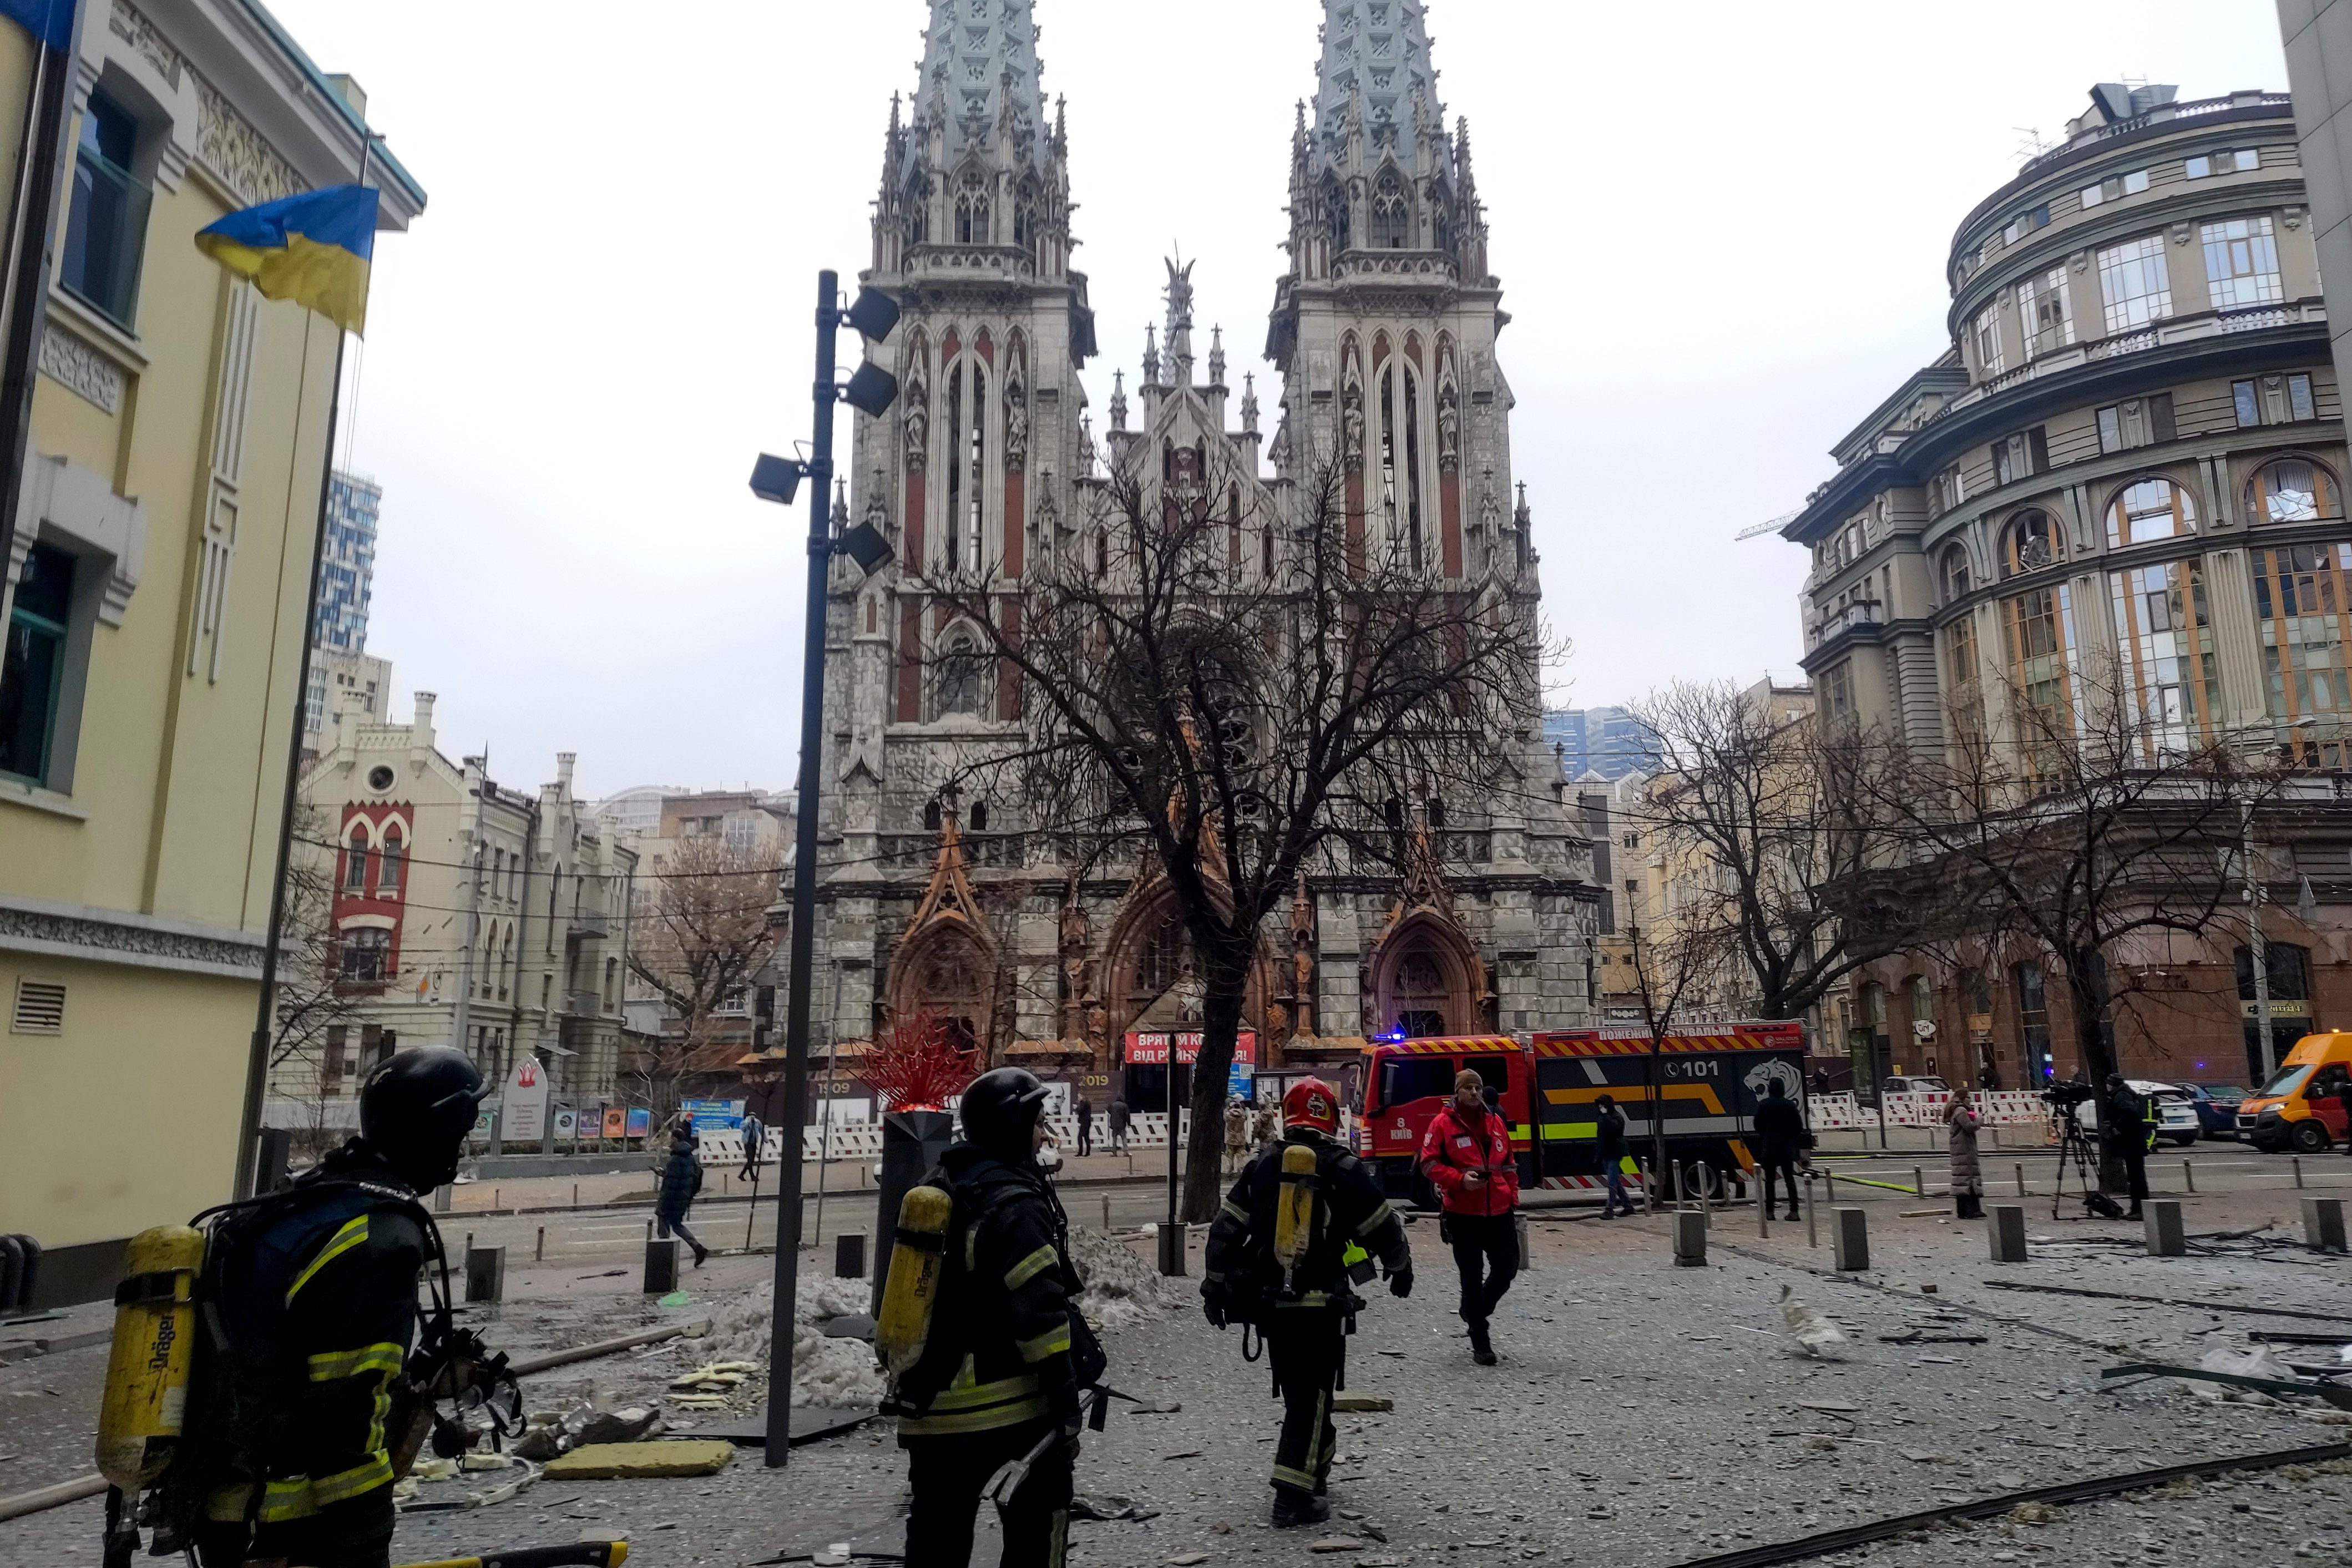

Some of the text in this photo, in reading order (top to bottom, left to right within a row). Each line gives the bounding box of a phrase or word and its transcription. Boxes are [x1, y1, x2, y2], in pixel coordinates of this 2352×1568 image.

[1134, 1050, 1155, 1063] ВІД
[1682, 1061, 1718, 1076] 101
[1078, 1075, 1109, 1086] 2019
[1397, 1117, 1405, 1127] 8
[1390, 1127, 1412, 1140] КИЇВ
[149, 1316, 175, 1368] Dräger
